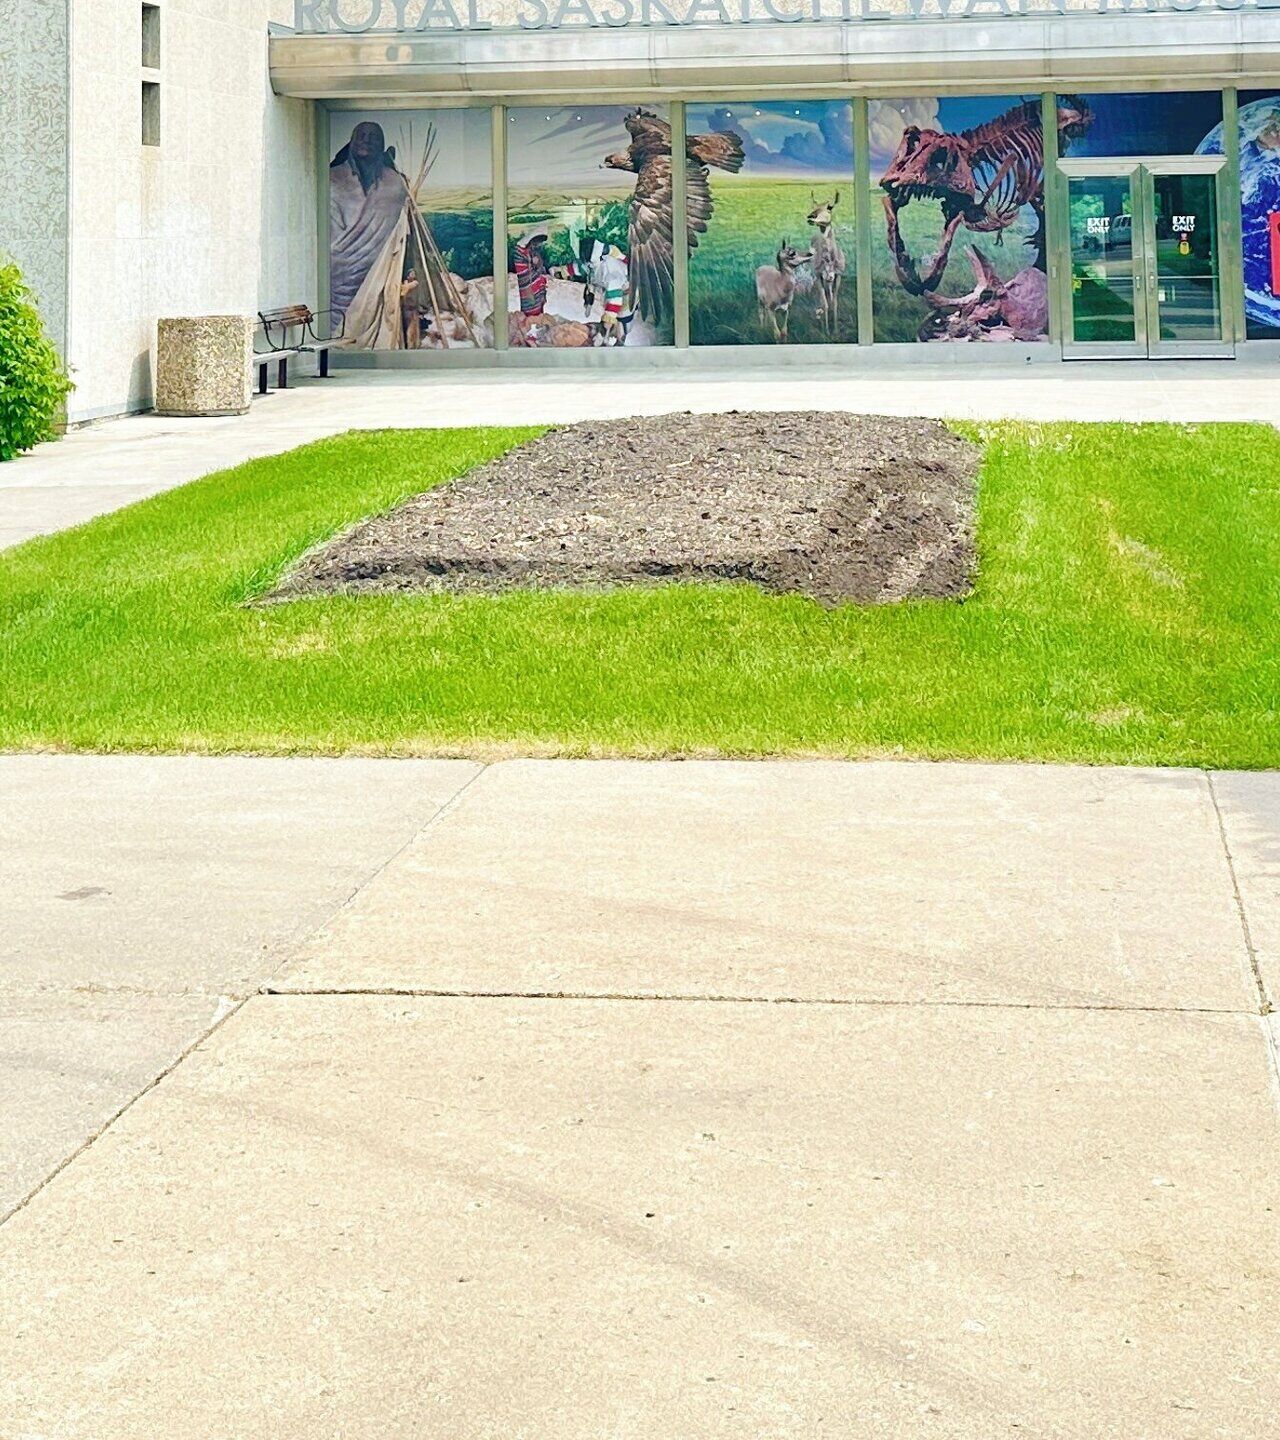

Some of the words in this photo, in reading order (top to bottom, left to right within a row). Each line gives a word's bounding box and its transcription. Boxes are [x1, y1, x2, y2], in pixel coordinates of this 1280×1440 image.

[1087, 217, 1110, 227] EXIT
[1172, 216, 1195, 225] EXIT
[1087, 226, 1110, 234] ONLY
[1172, 224, 1195, 232] ONLY
